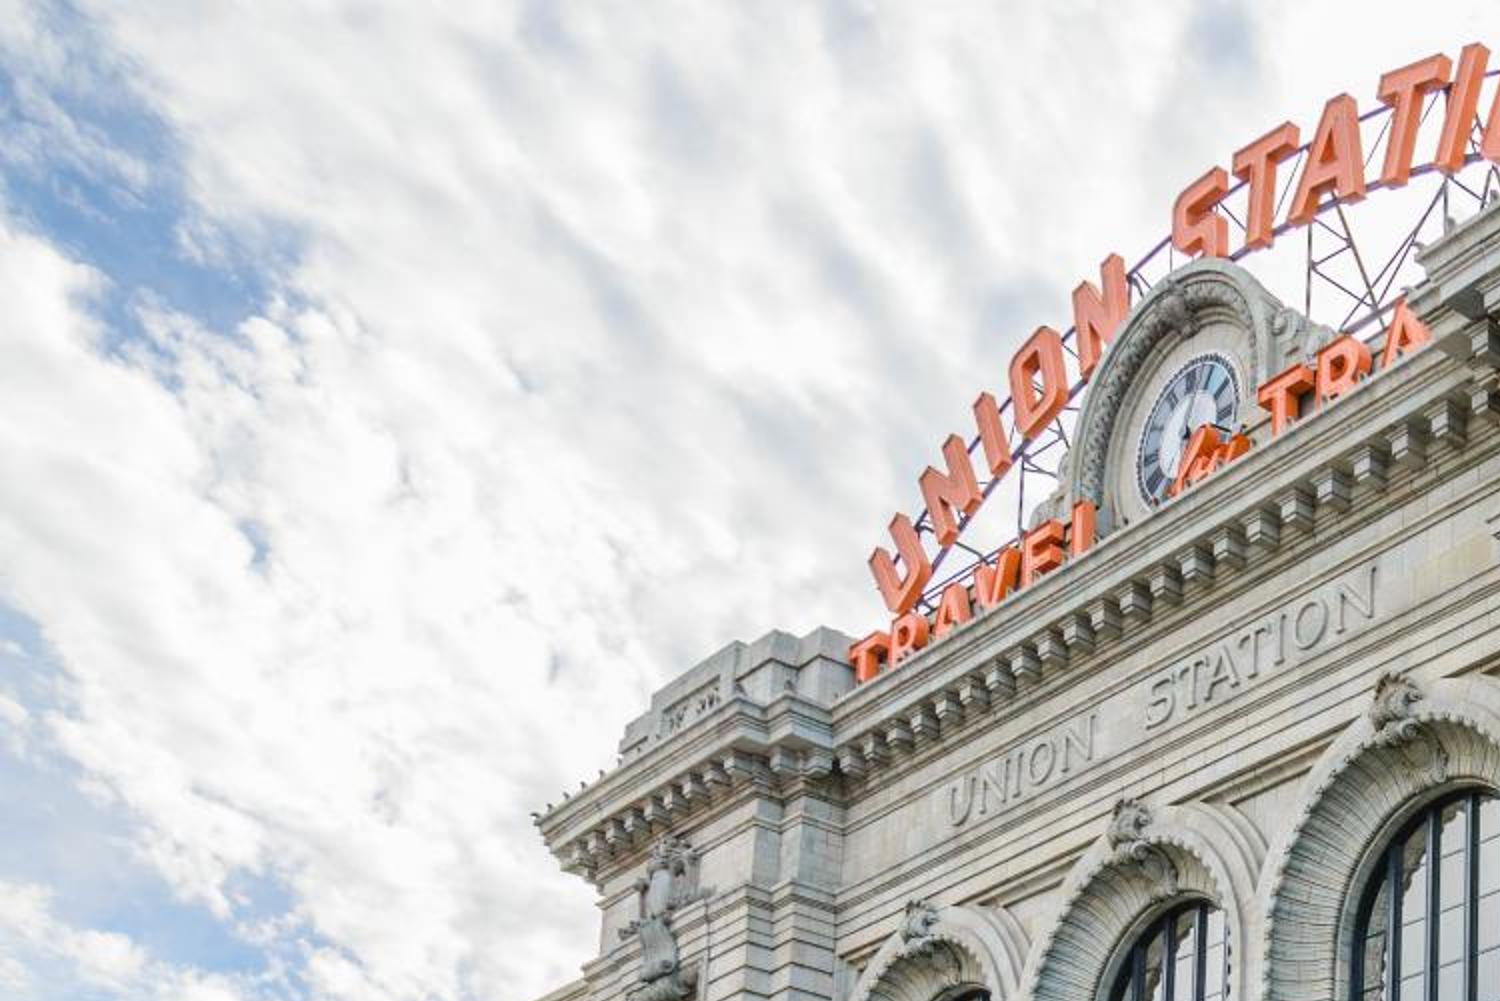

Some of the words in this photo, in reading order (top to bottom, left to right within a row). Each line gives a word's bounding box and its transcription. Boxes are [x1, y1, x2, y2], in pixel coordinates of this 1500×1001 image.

[868, 252, 1130, 614] UNION
[948, 714, 1098, 828] UNION
[1144, 565, 1378, 731] STATION
